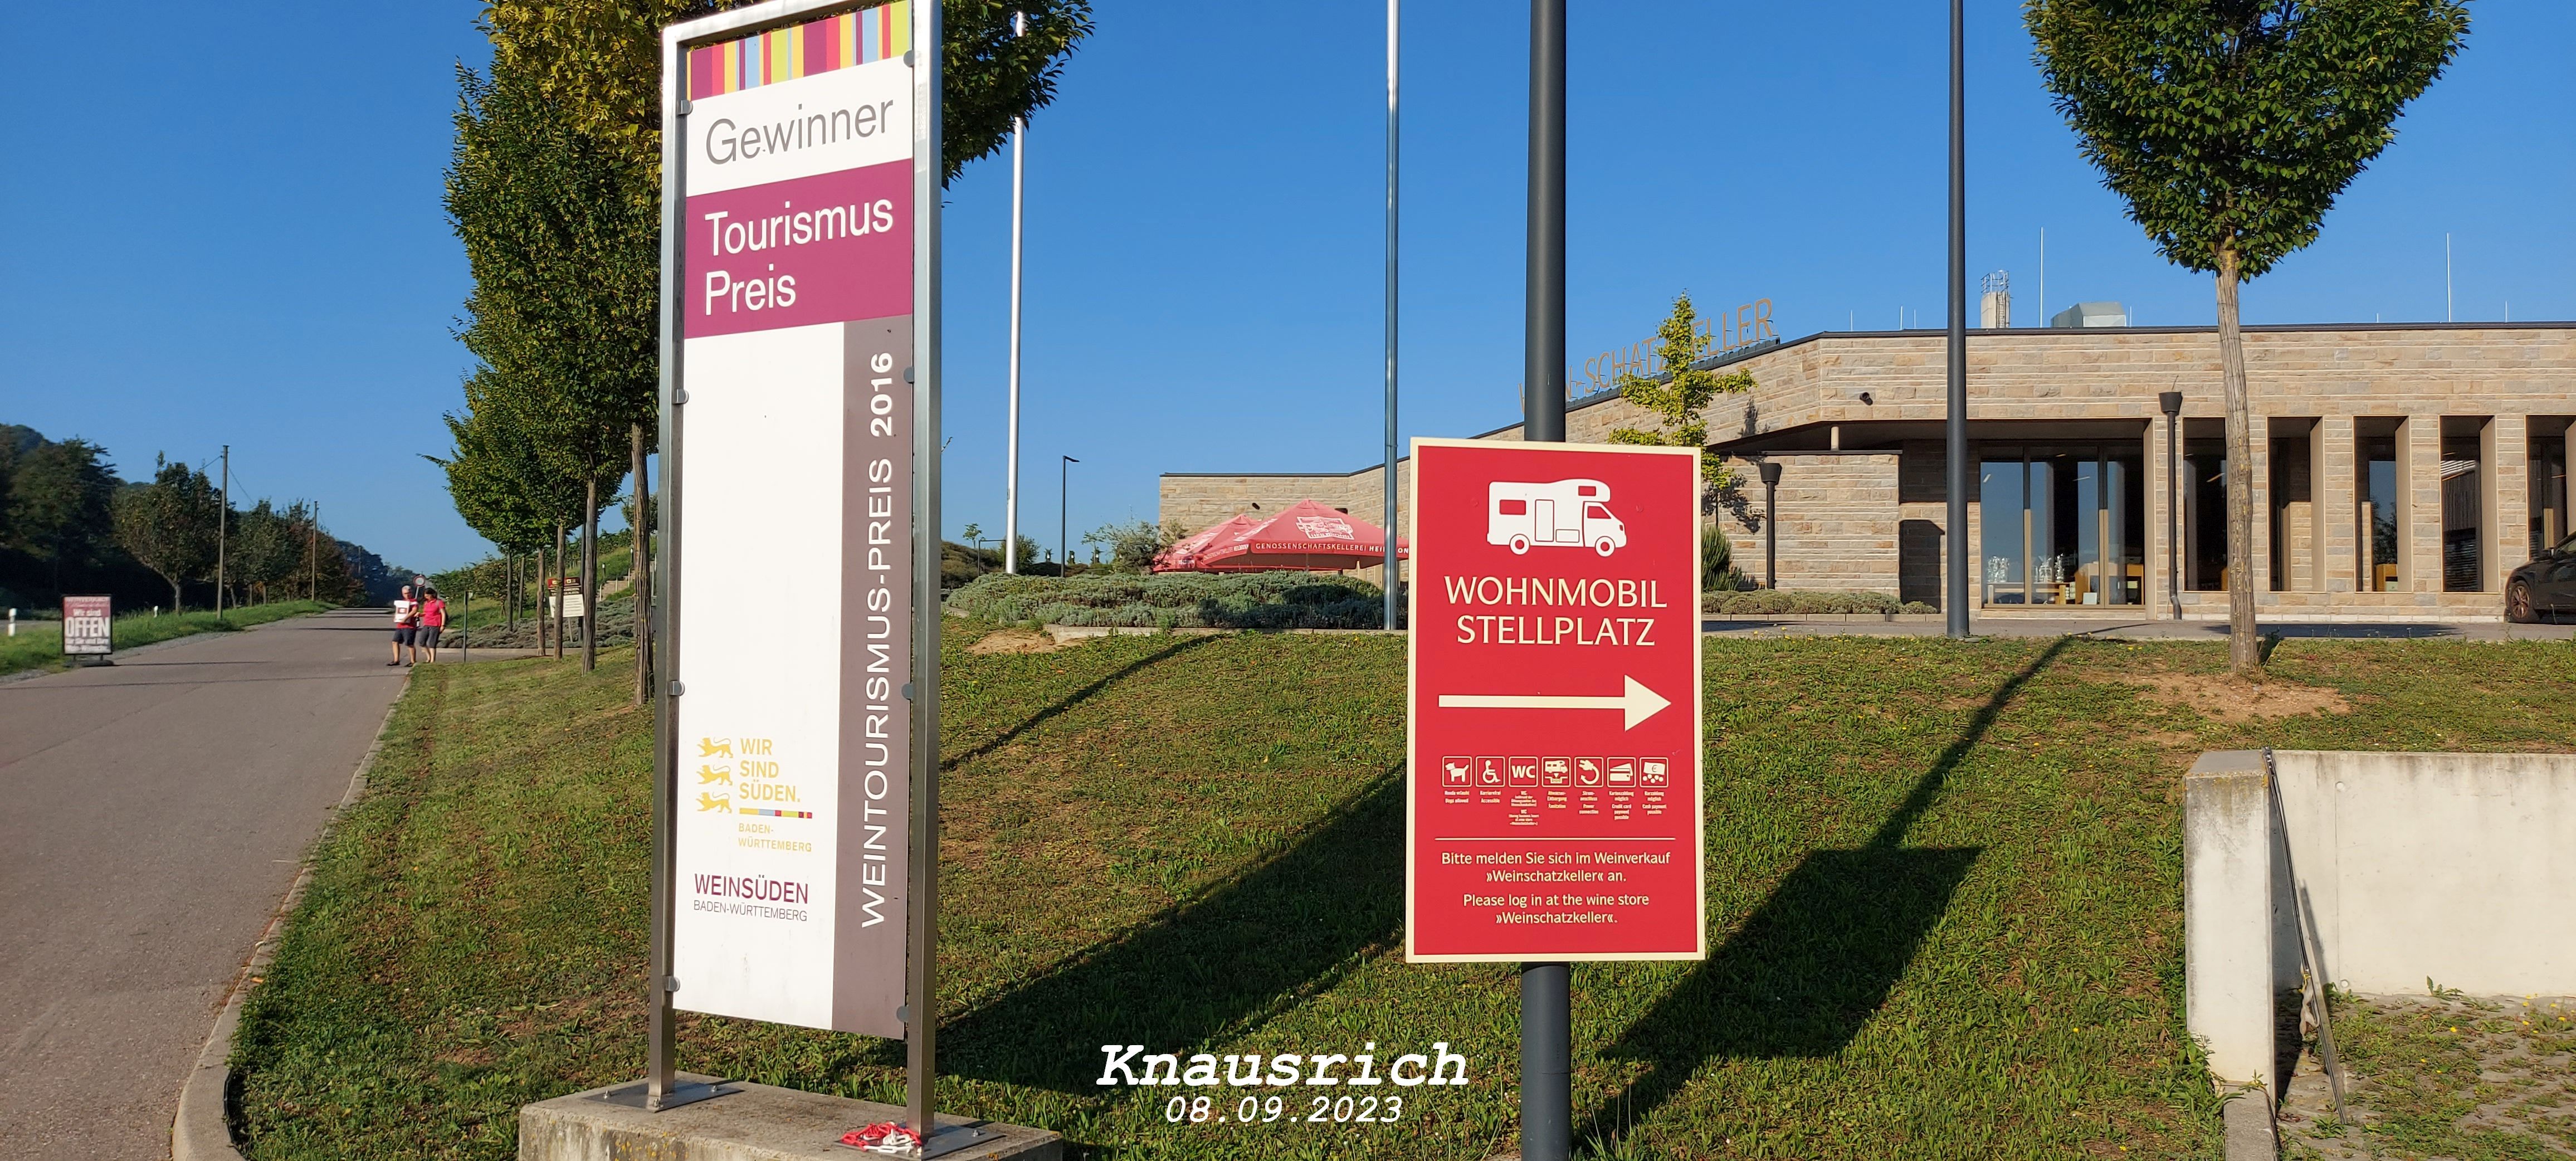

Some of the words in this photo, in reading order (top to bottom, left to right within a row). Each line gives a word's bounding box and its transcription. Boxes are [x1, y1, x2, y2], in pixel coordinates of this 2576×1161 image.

[706, 100, 893, 164] Gewinner
[705, 199, 894, 256] Tourismus
[705, 264, 796, 315] Preis
[870, 352, 892, 437] 2016
[1256, 543, 1366, 551] GENOSSENSCHAFTSKELLEREI
[1444, 576, 1667, 608] WOHNMOBIL
[65, 616, 109, 637] OFFEN
[1457, 615, 1655, 646] STELLPLATZ
[862, 458, 892, 928] WEINTOURISMUS-PREIS
[740, 738, 772, 755] WIR
[739, 760, 779, 778] SIND
[1511, 765, 1535, 778] WC
[739, 779, 801, 802] SÜDEN.
[739, 823, 774, 834] BADEN-
[738, 836, 812, 852] WÜRTTEMBERG
[1442, 852, 1472, 864] Bitte
[1476, 852, 1522, 864] melden
[1526, 852, 1545, 864] Sie
[1548, 852, 1572, 864] sich
[1576, 852, 1591, 864] im
[1594, 852, 1670, 864] Weinverkauf
[1608, 871, 1626, 881] an.
[694, 874, 808, 904] WEINSÜDEN
[693, 900, 808, 921] BADEN-WÜRTTEMBERG
[1463, 894, 1505, 906] Please
[1509, 894, 1527, 908] log
[1531, 894, 1542, 905] in
[1546, 895, 1559, 905] at
[1563, 894, 1582, 905] the
[1586, 894, 1614, 905] wine
[1618, 895, 1649, 905] store
